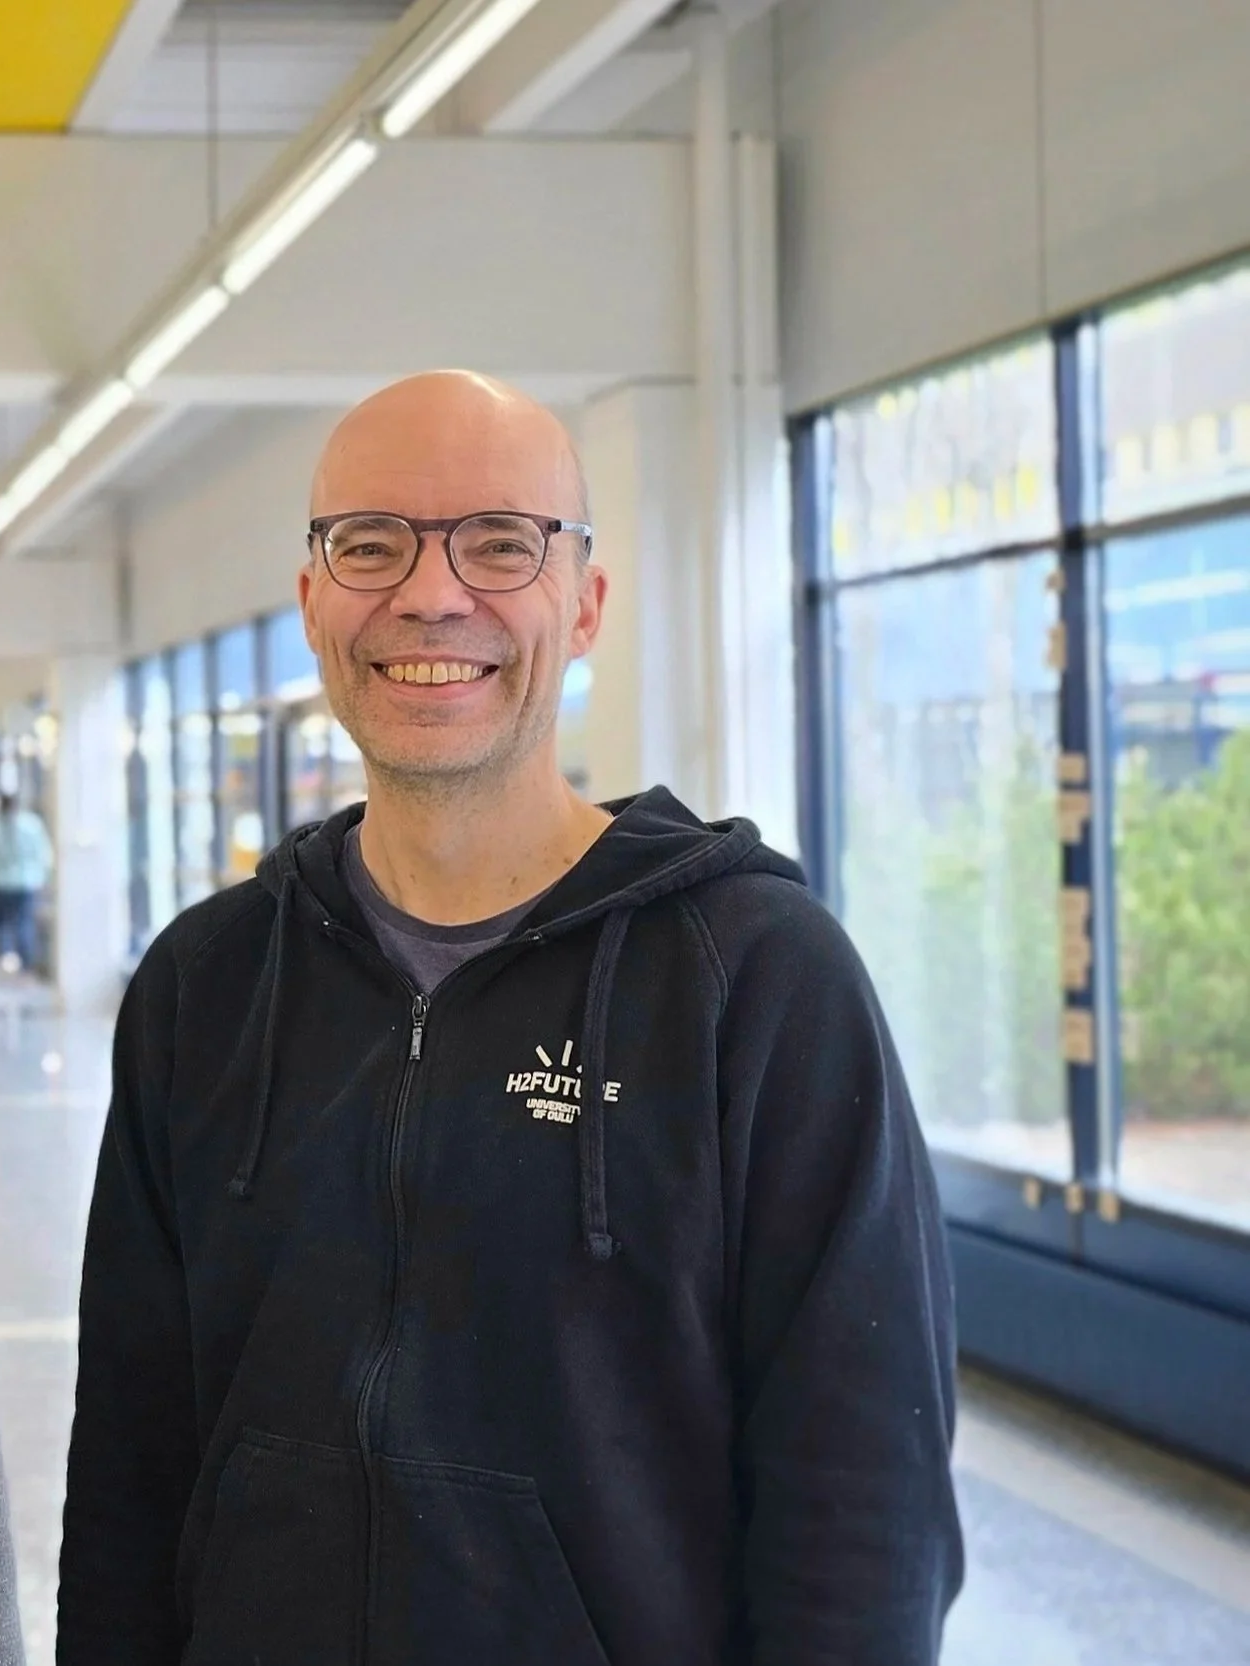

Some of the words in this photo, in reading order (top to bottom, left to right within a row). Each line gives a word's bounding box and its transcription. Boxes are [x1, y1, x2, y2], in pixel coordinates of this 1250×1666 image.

[506, 1071, 621, 1101] H2FUTE
[532, 1108, 547, 1119] OF
[547, 1110, 574, 1124] OULU
